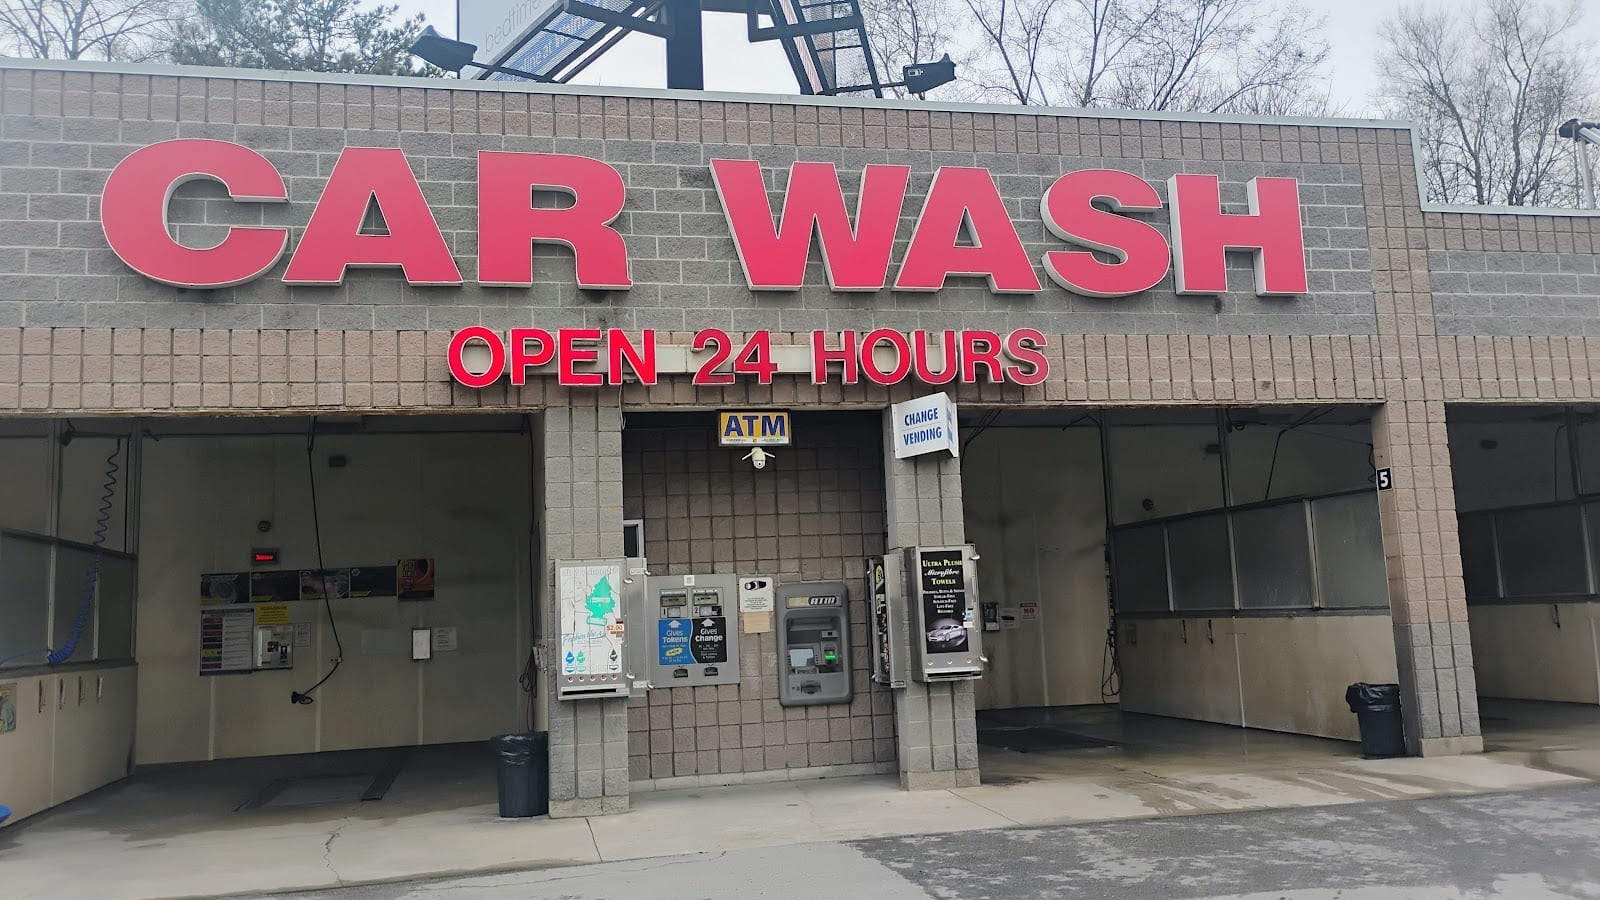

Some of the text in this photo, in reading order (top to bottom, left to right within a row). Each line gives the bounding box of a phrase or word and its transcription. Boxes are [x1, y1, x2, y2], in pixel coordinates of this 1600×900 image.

[100, 137, 1309, 298] CAR WASH
[447, 325, 1050, 388] OPEN 24 HOURS
[723, 415, 786, 437] ATM
[904, 407, 939, 427] CHANGE
[903, 426, 942, 446] VENDING
[1379, 471, 1389, 488] 5
[810, 597, 836, 605] ATM
